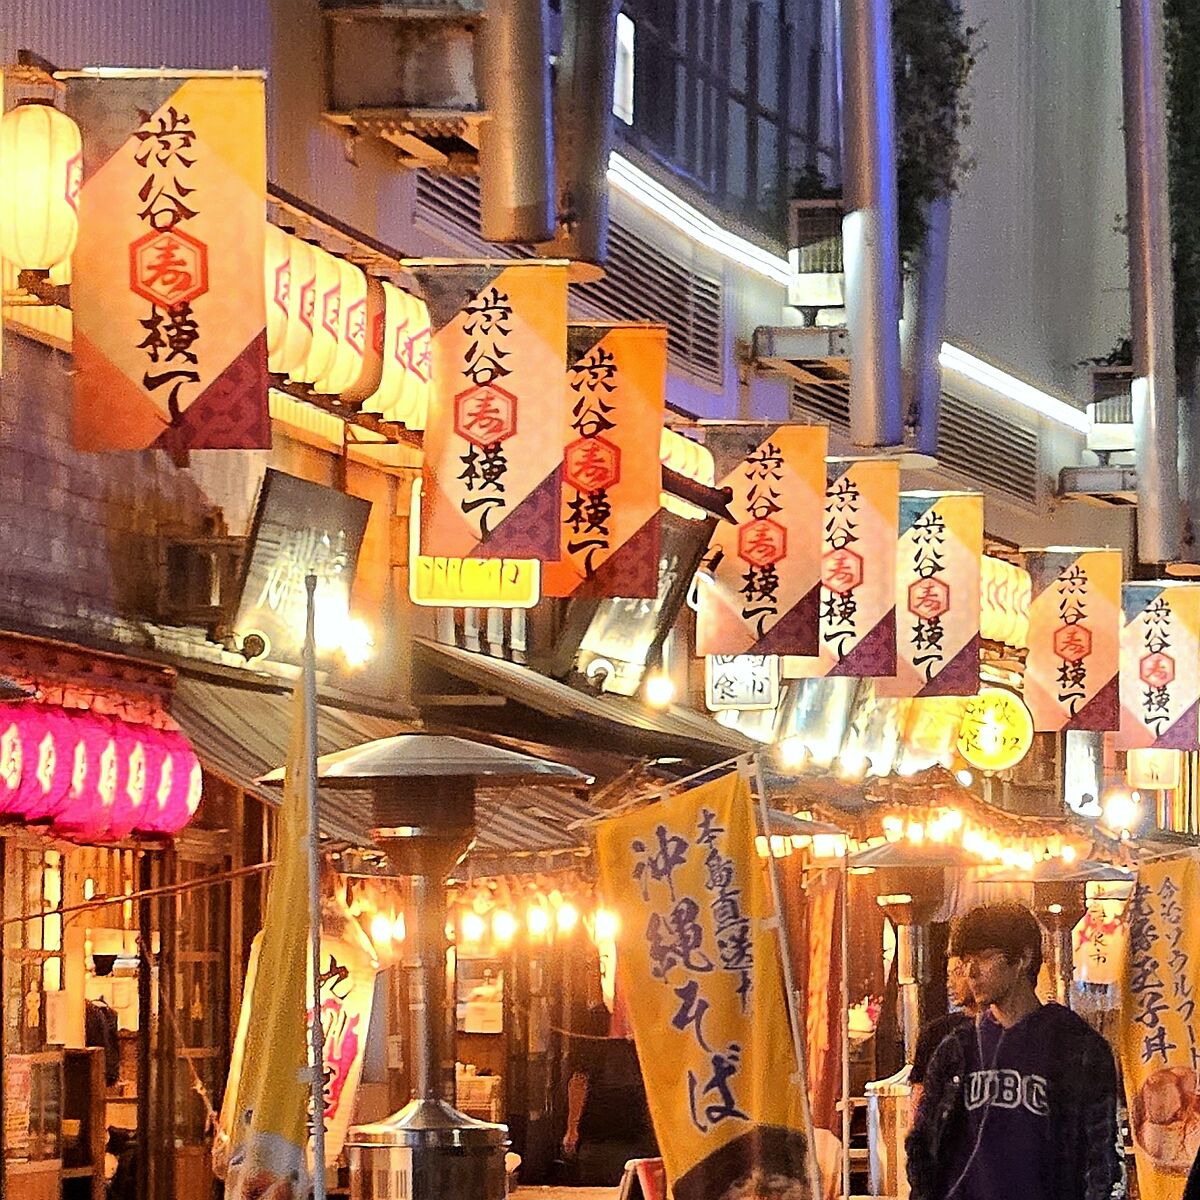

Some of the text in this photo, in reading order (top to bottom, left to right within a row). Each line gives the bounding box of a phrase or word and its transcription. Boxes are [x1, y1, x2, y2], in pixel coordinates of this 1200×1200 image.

[631, 825, 751, 1132] 沖縄そば
[964, 1069, 1050, 1116] UBC
